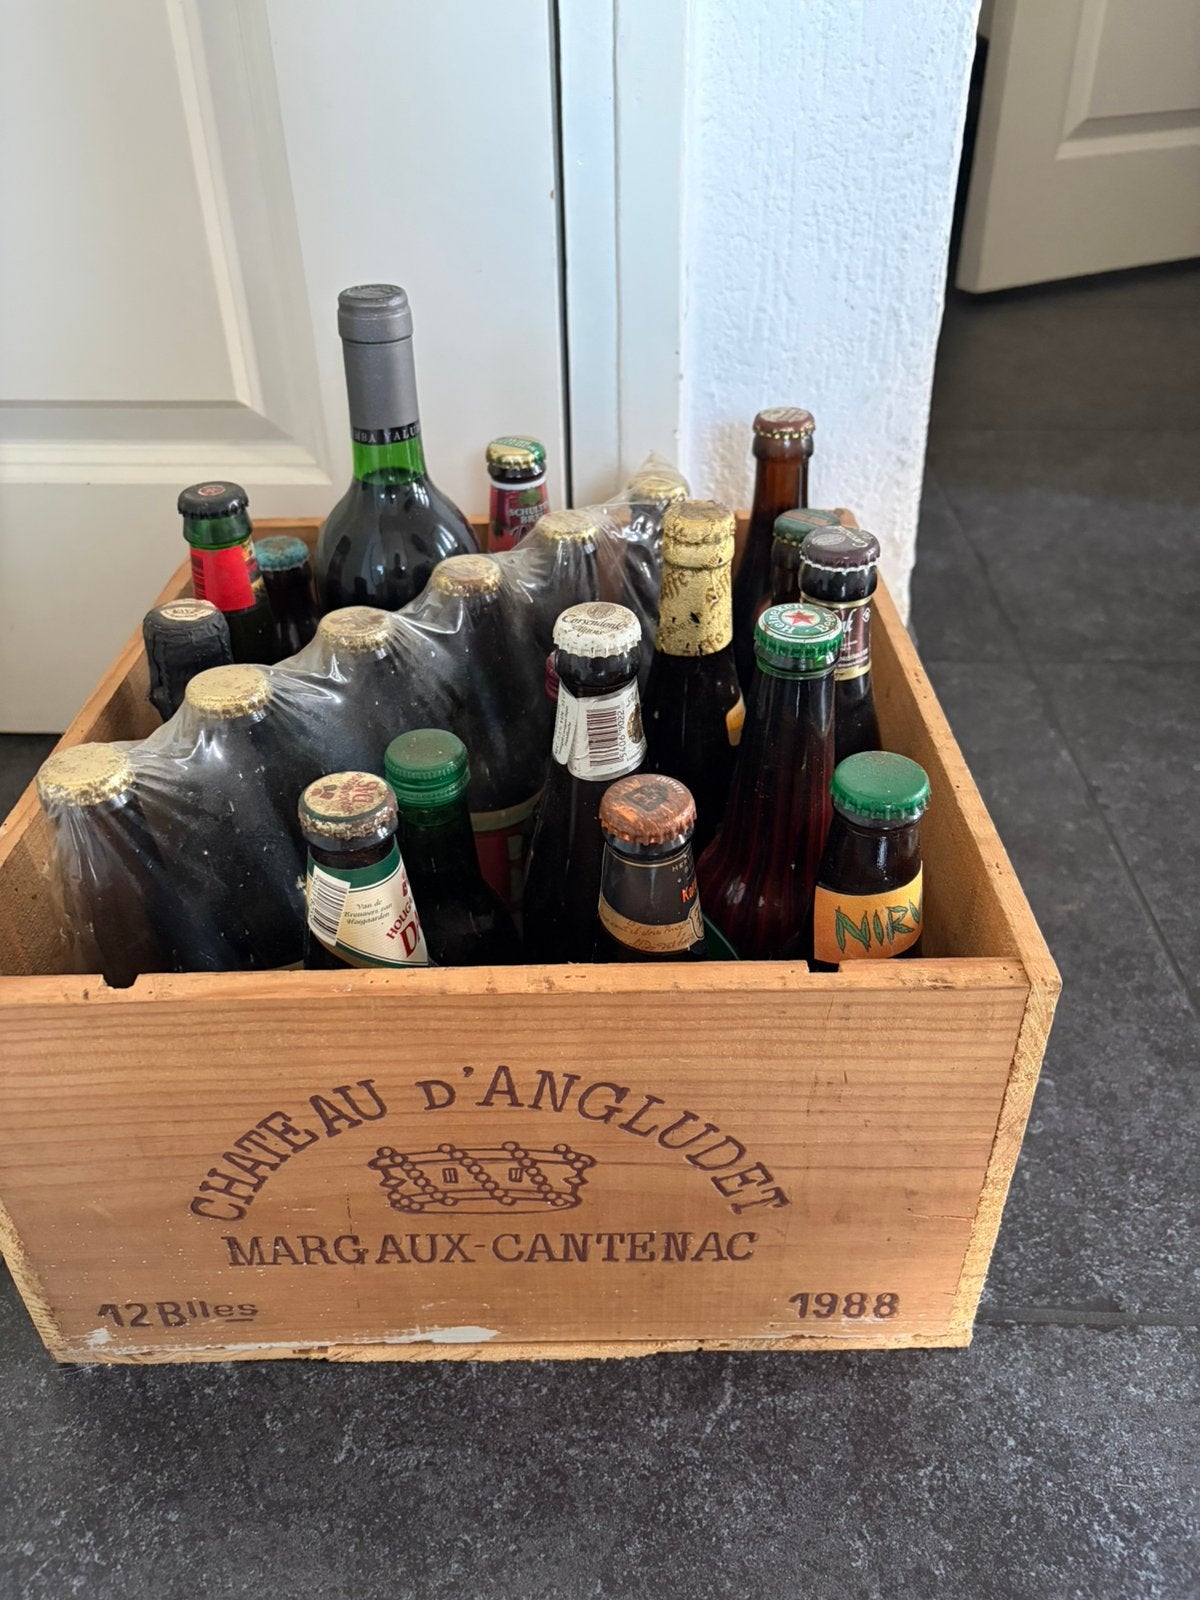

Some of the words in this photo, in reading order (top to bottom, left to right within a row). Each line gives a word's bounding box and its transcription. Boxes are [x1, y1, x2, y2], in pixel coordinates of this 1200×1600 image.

[561, 613, 626, 631] Corsendonk
[768, 603, 804, 634] Heineken
[814, 611, 837, 633] Beer
[386, 897, 413, 940] HOUG
[190, 1077, 389, 1222] CHATEAU
[415, 1064, 792, 1216] D'ANGLUDET
[220, 1231, 759, 1267] MARGAUX-CANTENAC
[789, 1291, 899, 1320] 1988
